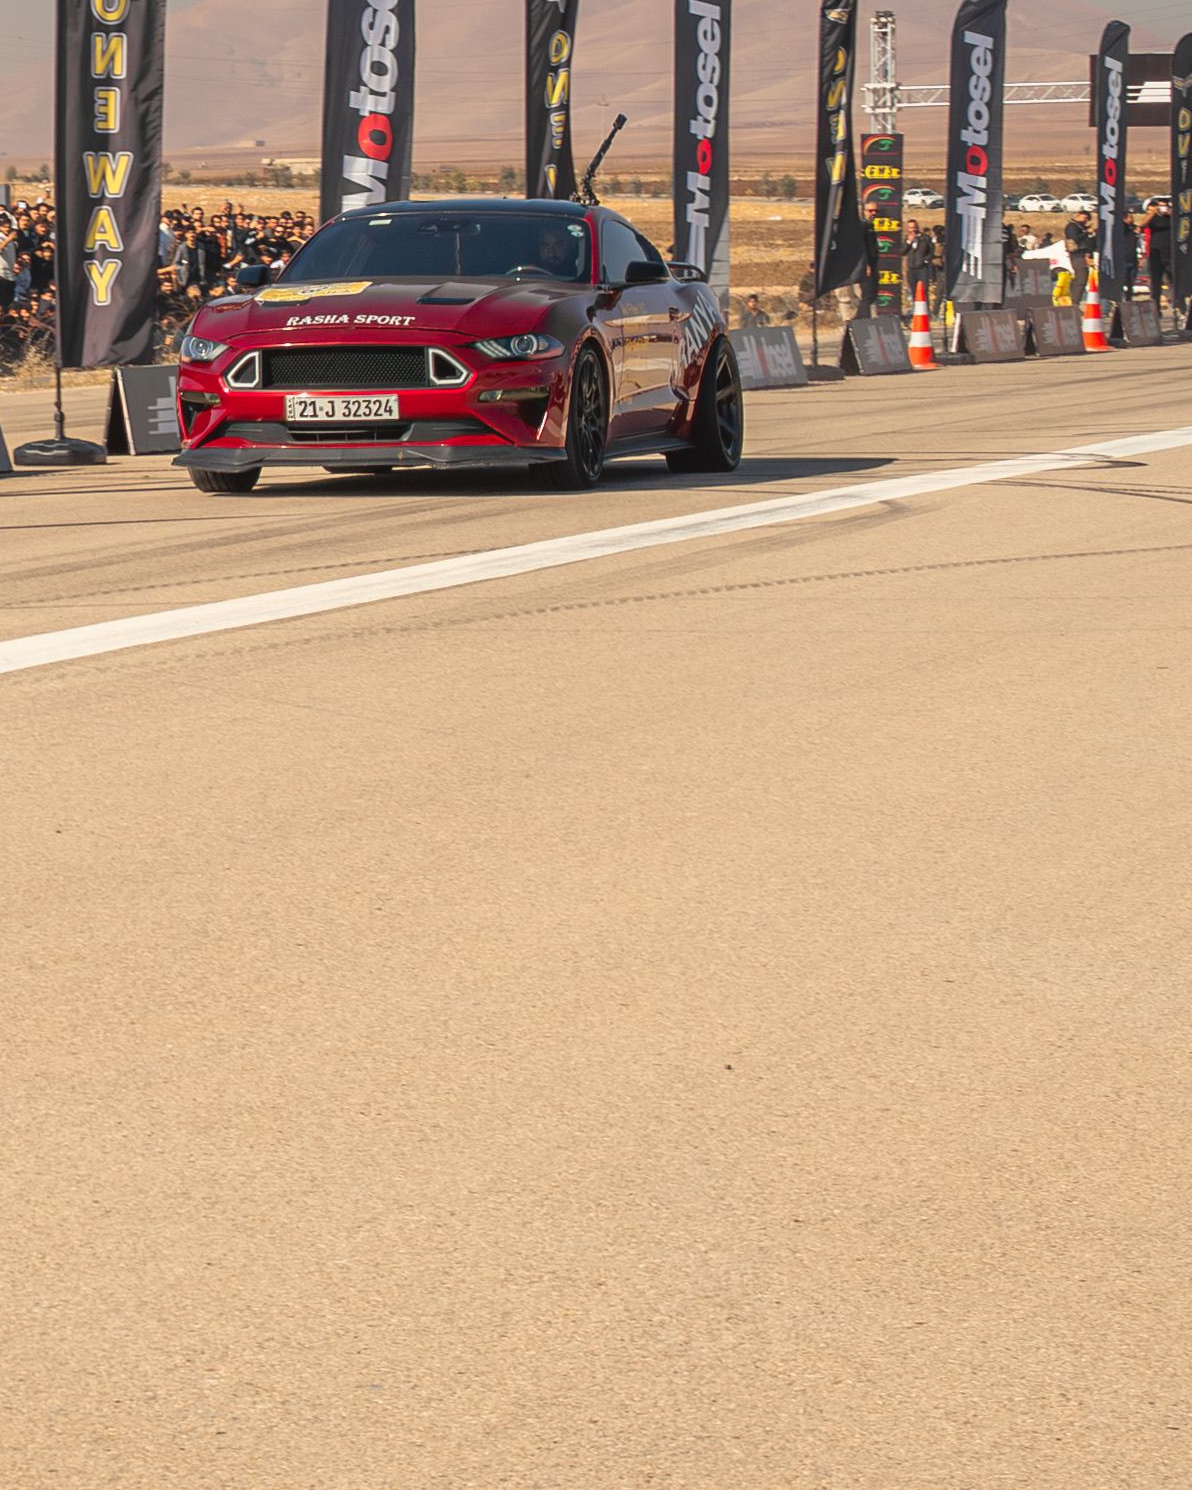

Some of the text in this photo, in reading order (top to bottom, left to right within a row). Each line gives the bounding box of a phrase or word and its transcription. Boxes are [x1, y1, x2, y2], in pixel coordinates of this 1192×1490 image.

[956, 30, 995, 215] Motosel
[1099, 56, 1124, 220] Motosel
[286, 314, 416, 327] RASHA SPORT
[298, 400, 319, 418] 21
[325, 400, 335, 418] J
[341, 399, 393, 418] 32324
